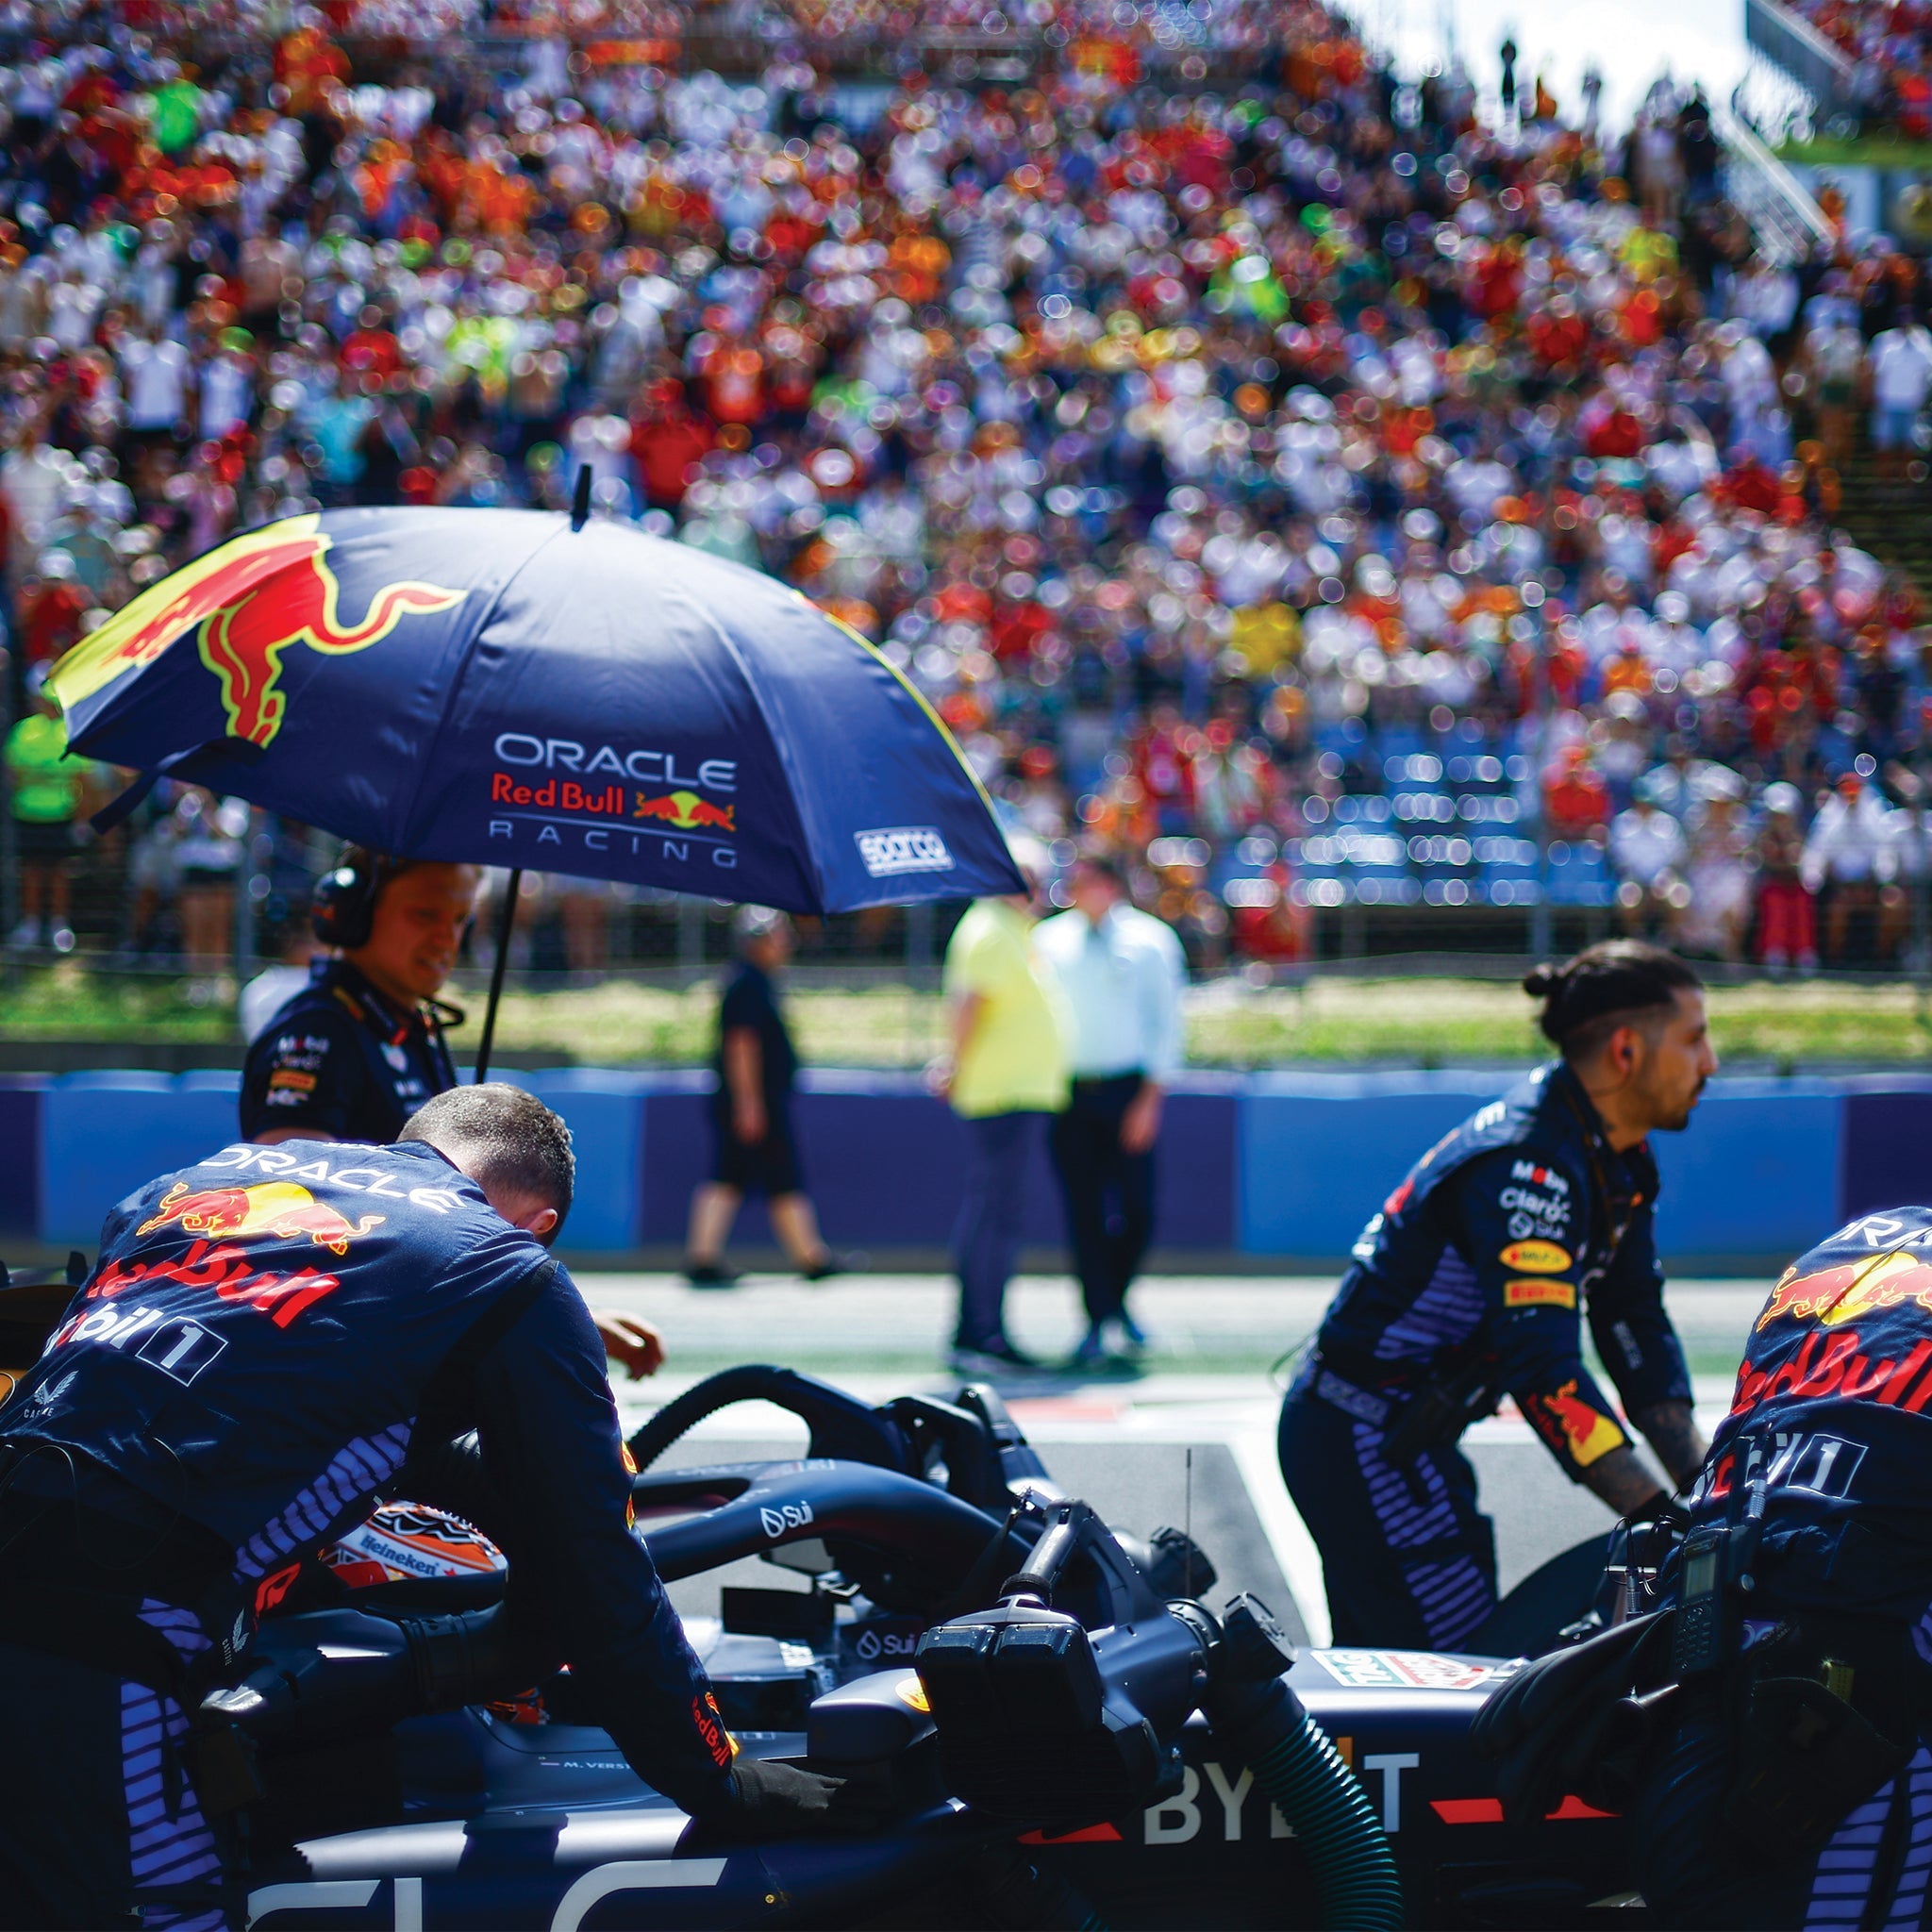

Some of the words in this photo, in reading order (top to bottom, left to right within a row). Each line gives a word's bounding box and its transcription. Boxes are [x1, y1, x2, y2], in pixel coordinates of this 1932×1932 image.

[493, 732, 738, 792] ORACLE
[491, 773, 557, 808] Red
[561, 782, 624, 815] Bull
[489, 820, 738, 868] RACING
[196, 1147, 468, 1214] ORACLE
[1498, 1186, 1562, 1224] Claro
[1820, 1216, 1932, 1248] RA
[160, 1324, 205, 1369] 1
[1809, 1441, 1843, 1491] 1
[781, 1500, 814, 1528] Sui
[360, 1534, 438, 1576] Heineken
[883, 1631, 916, 1655] Sui
[1143, 1737, 1420, 1845] BYT
